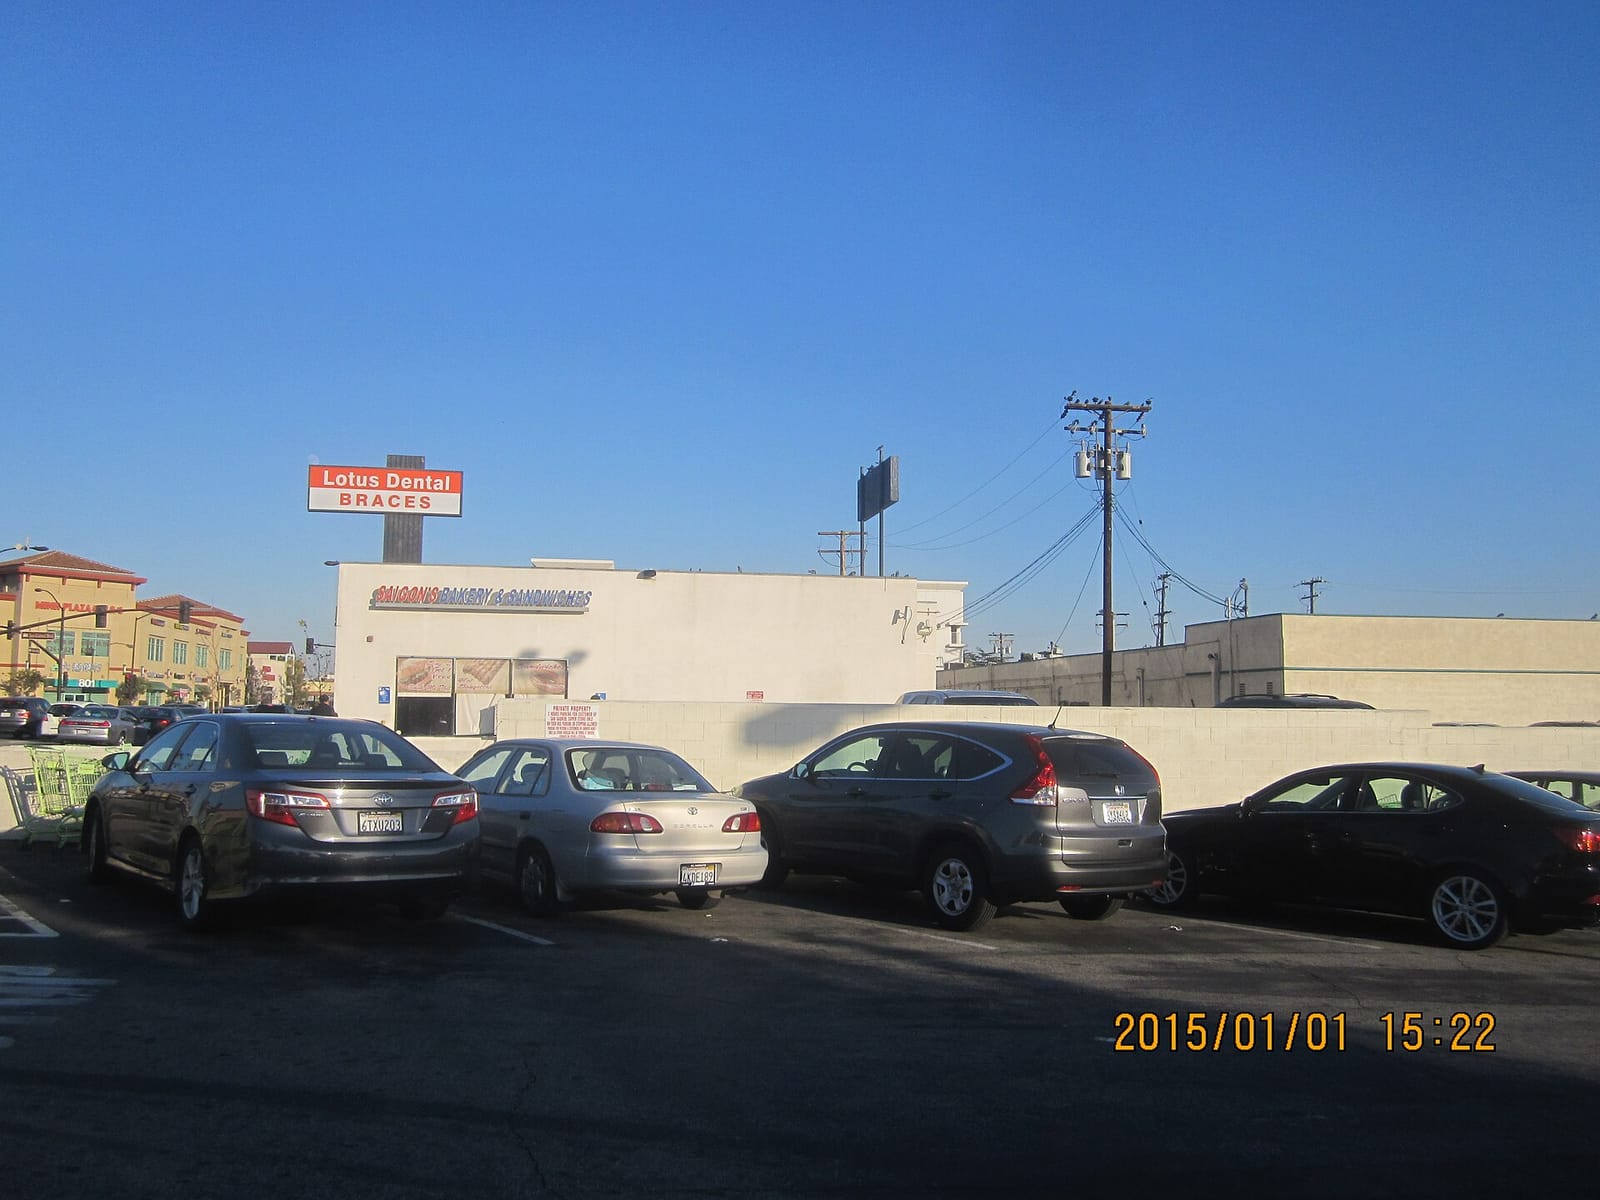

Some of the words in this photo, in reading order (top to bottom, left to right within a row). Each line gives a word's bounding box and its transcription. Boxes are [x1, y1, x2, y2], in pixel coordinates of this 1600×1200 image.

[322, 470, 380, 488] Lotus
[386, 473, 451, 491] Dental
[339, 493, 432, 509] BRACES
[376, 585, 438, 603] SAIGON'S
[439, 587, 493, 605] BAKERY
[494, 588, 502, 605] &
[508, 589, 593, 606] SANDWICHES
[79, 679, 95, 687] 801
[362, 819, 401, 832] 6TXU203
